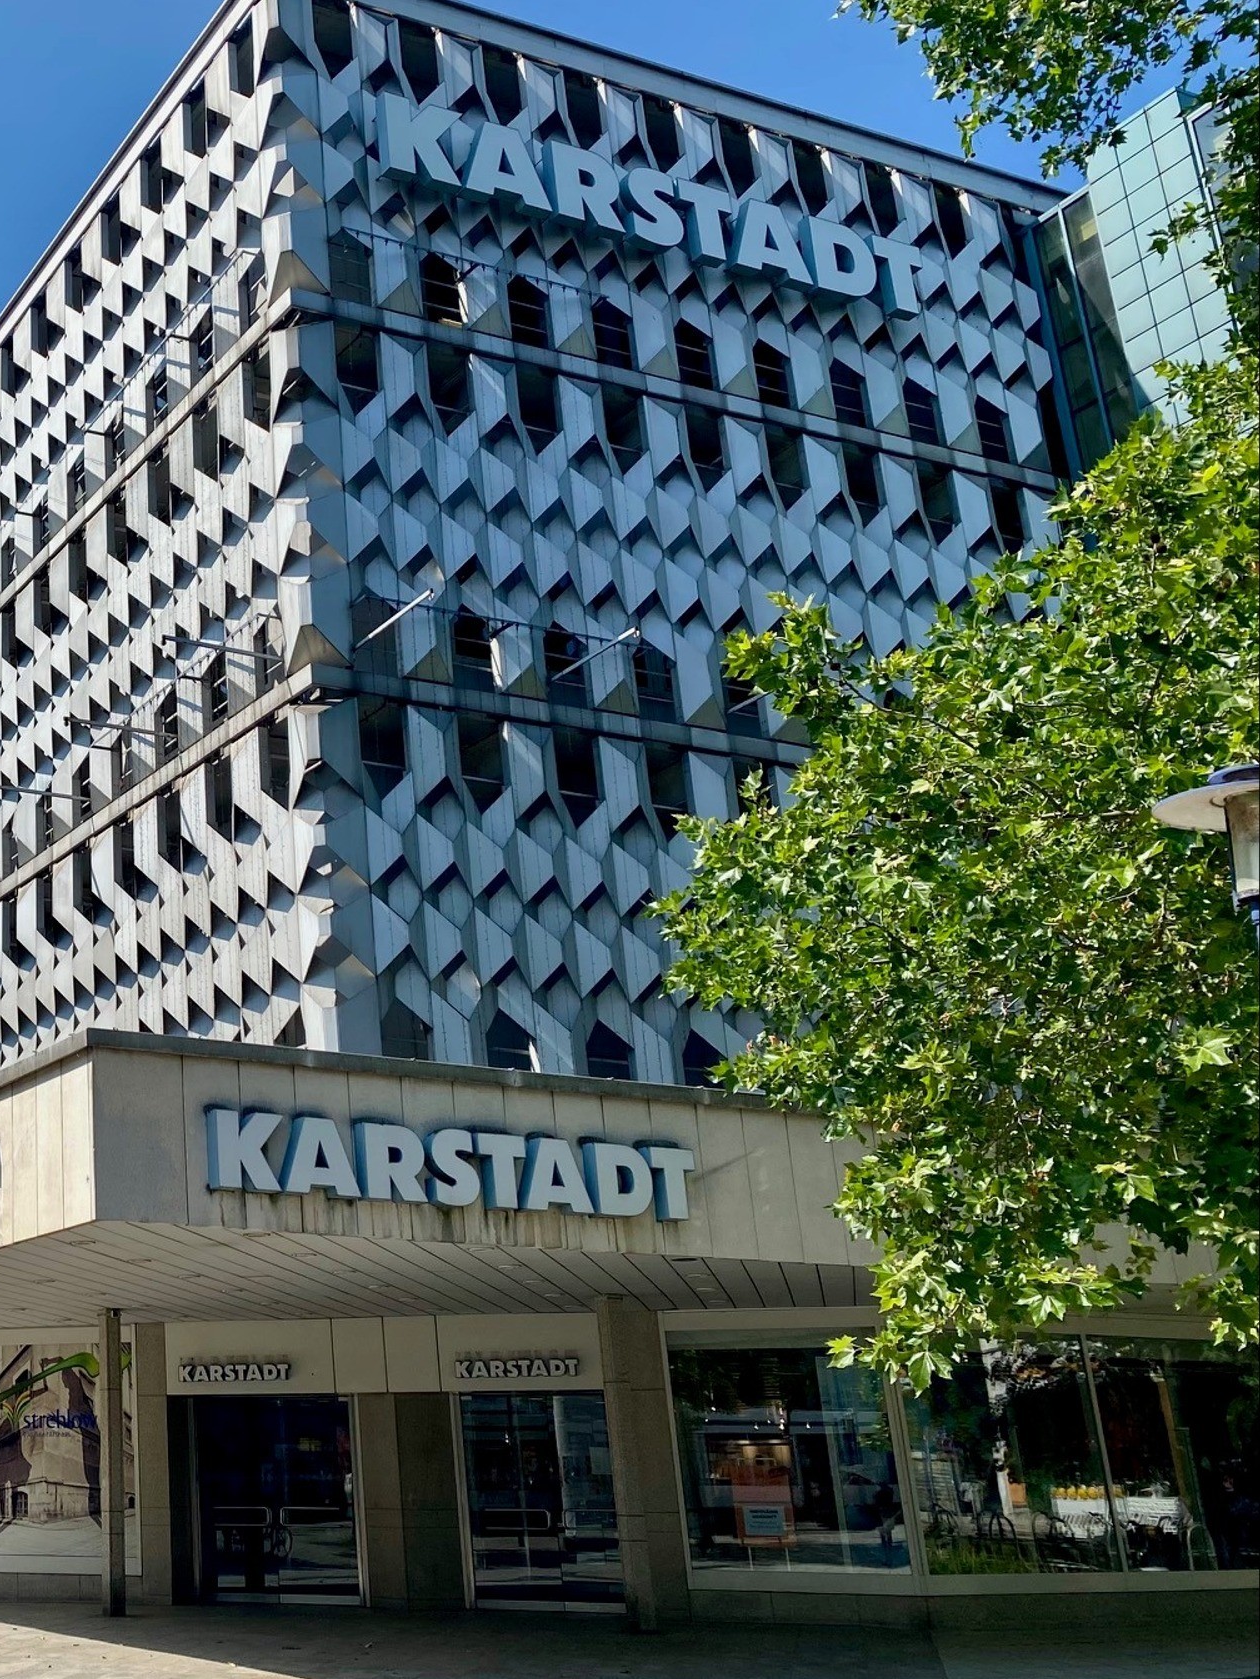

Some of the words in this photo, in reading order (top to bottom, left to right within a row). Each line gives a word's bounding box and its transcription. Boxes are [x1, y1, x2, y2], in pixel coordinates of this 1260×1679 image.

[378, 91, 922, 321] KARSTADT
[207, 1108, 695, 1222] KARSTADT
[179, 1363, 290, 1382] KARSTADT
[454, 1358, 579, 1378] KARSTADT
[23, 1409, 98, 1429] strehlow
